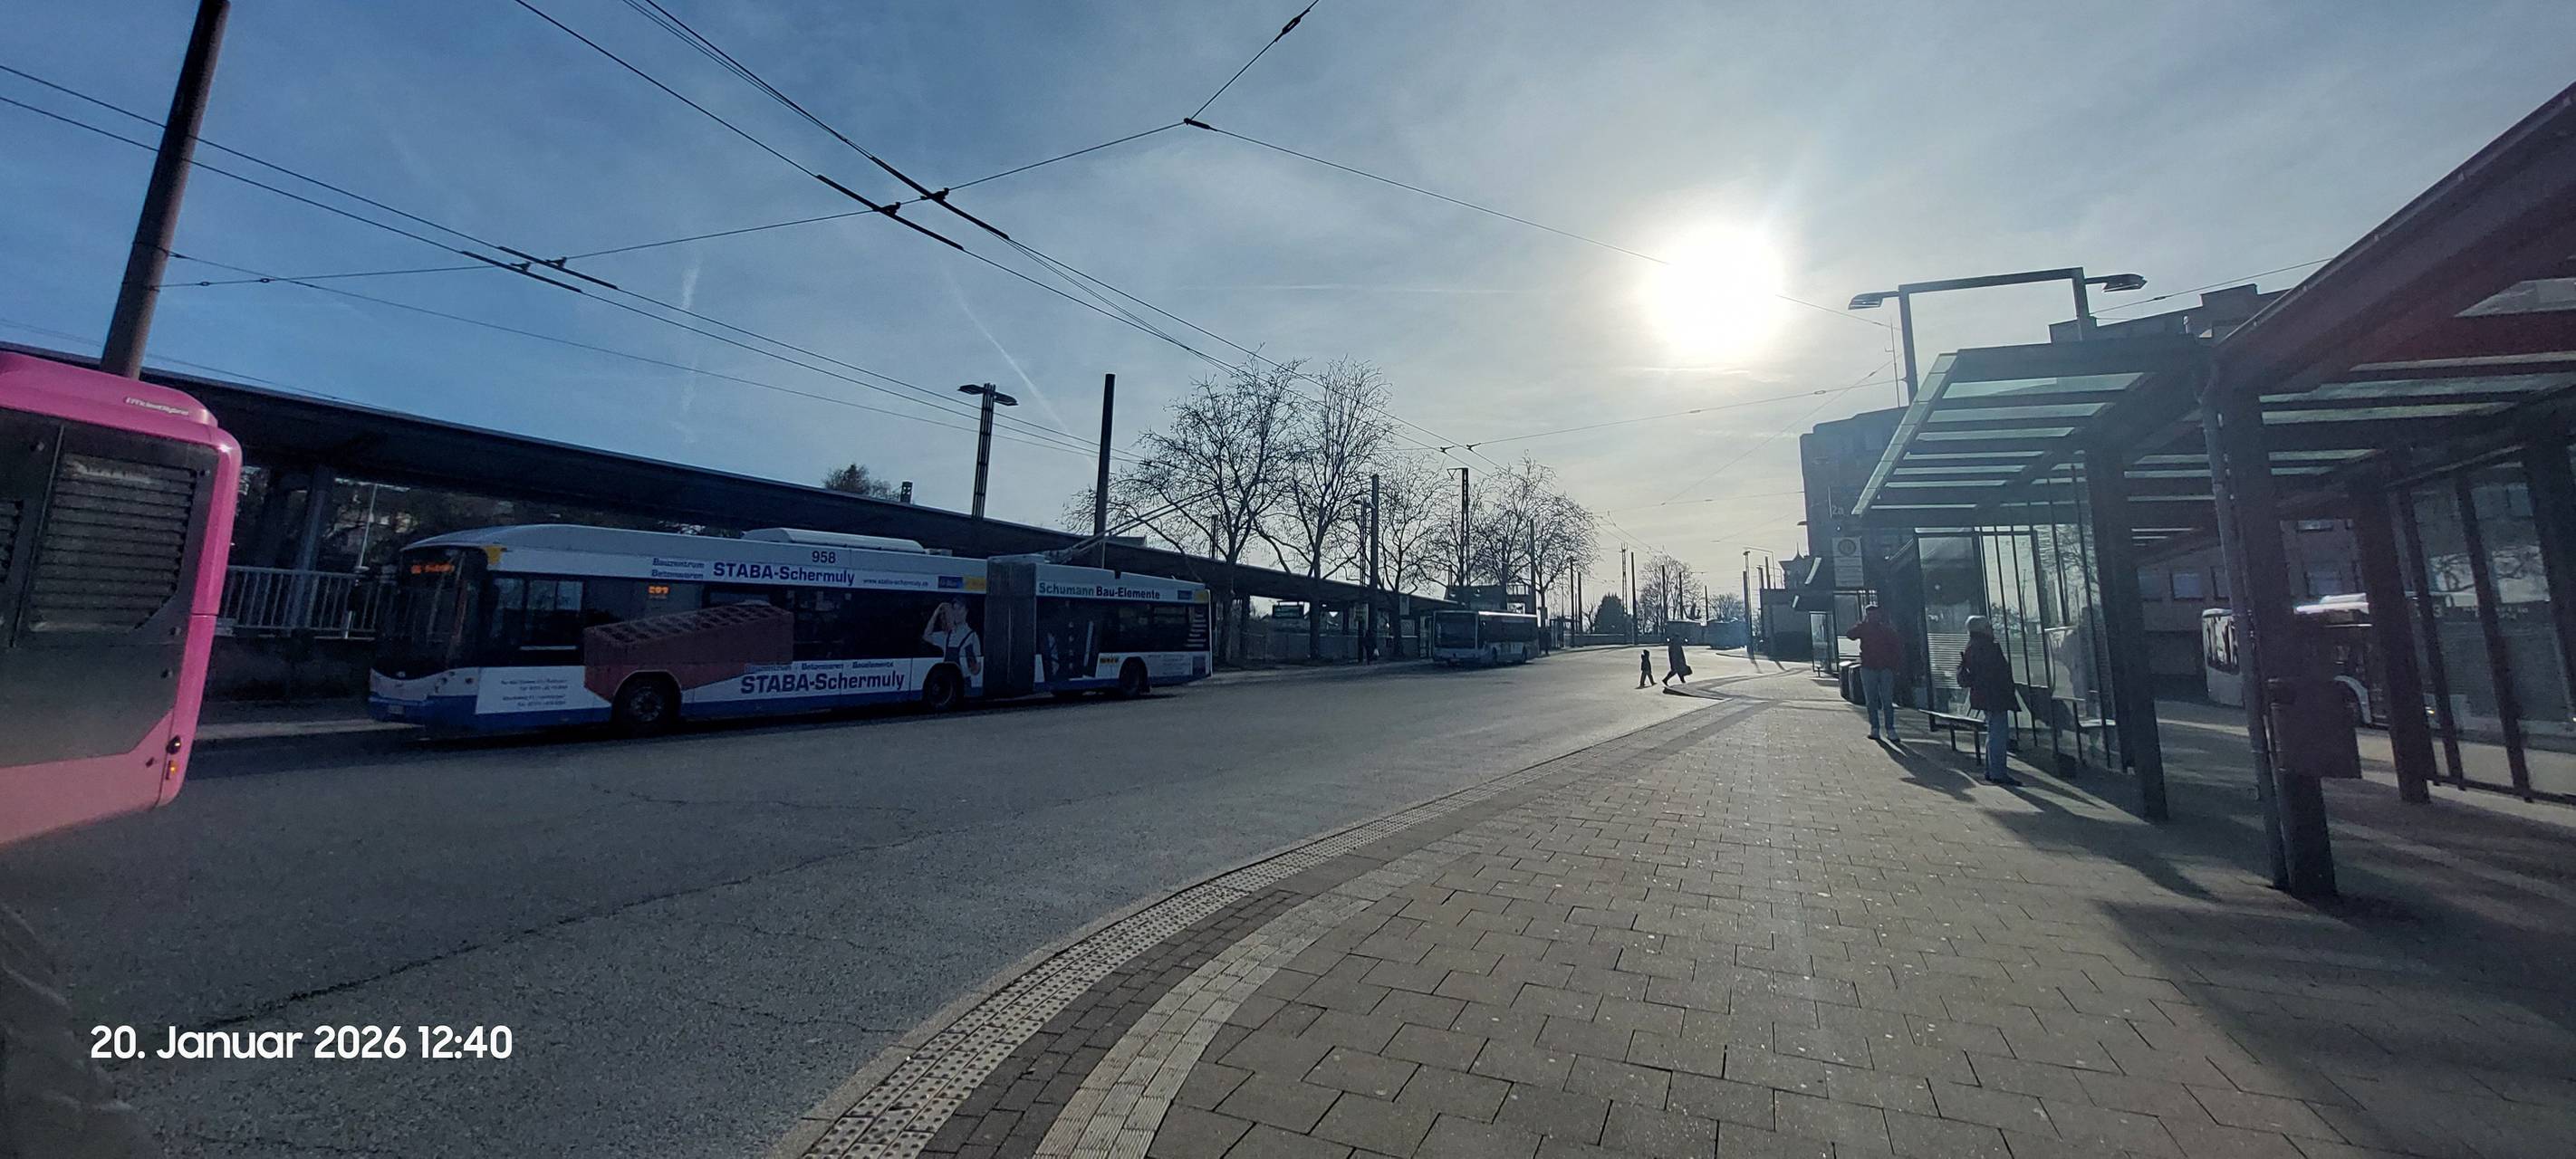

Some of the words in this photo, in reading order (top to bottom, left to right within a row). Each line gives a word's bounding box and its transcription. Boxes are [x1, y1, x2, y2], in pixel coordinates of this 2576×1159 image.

[812, 551, 836, 563] 958
[714, 561, 855, 586] STABA-Schermuly
[1038, 582, 1094, 597] Schumann
[1096, 586, 1160, 599] Bau-Elemente
[741, 670, 905, 694] STABA-Schermuly
